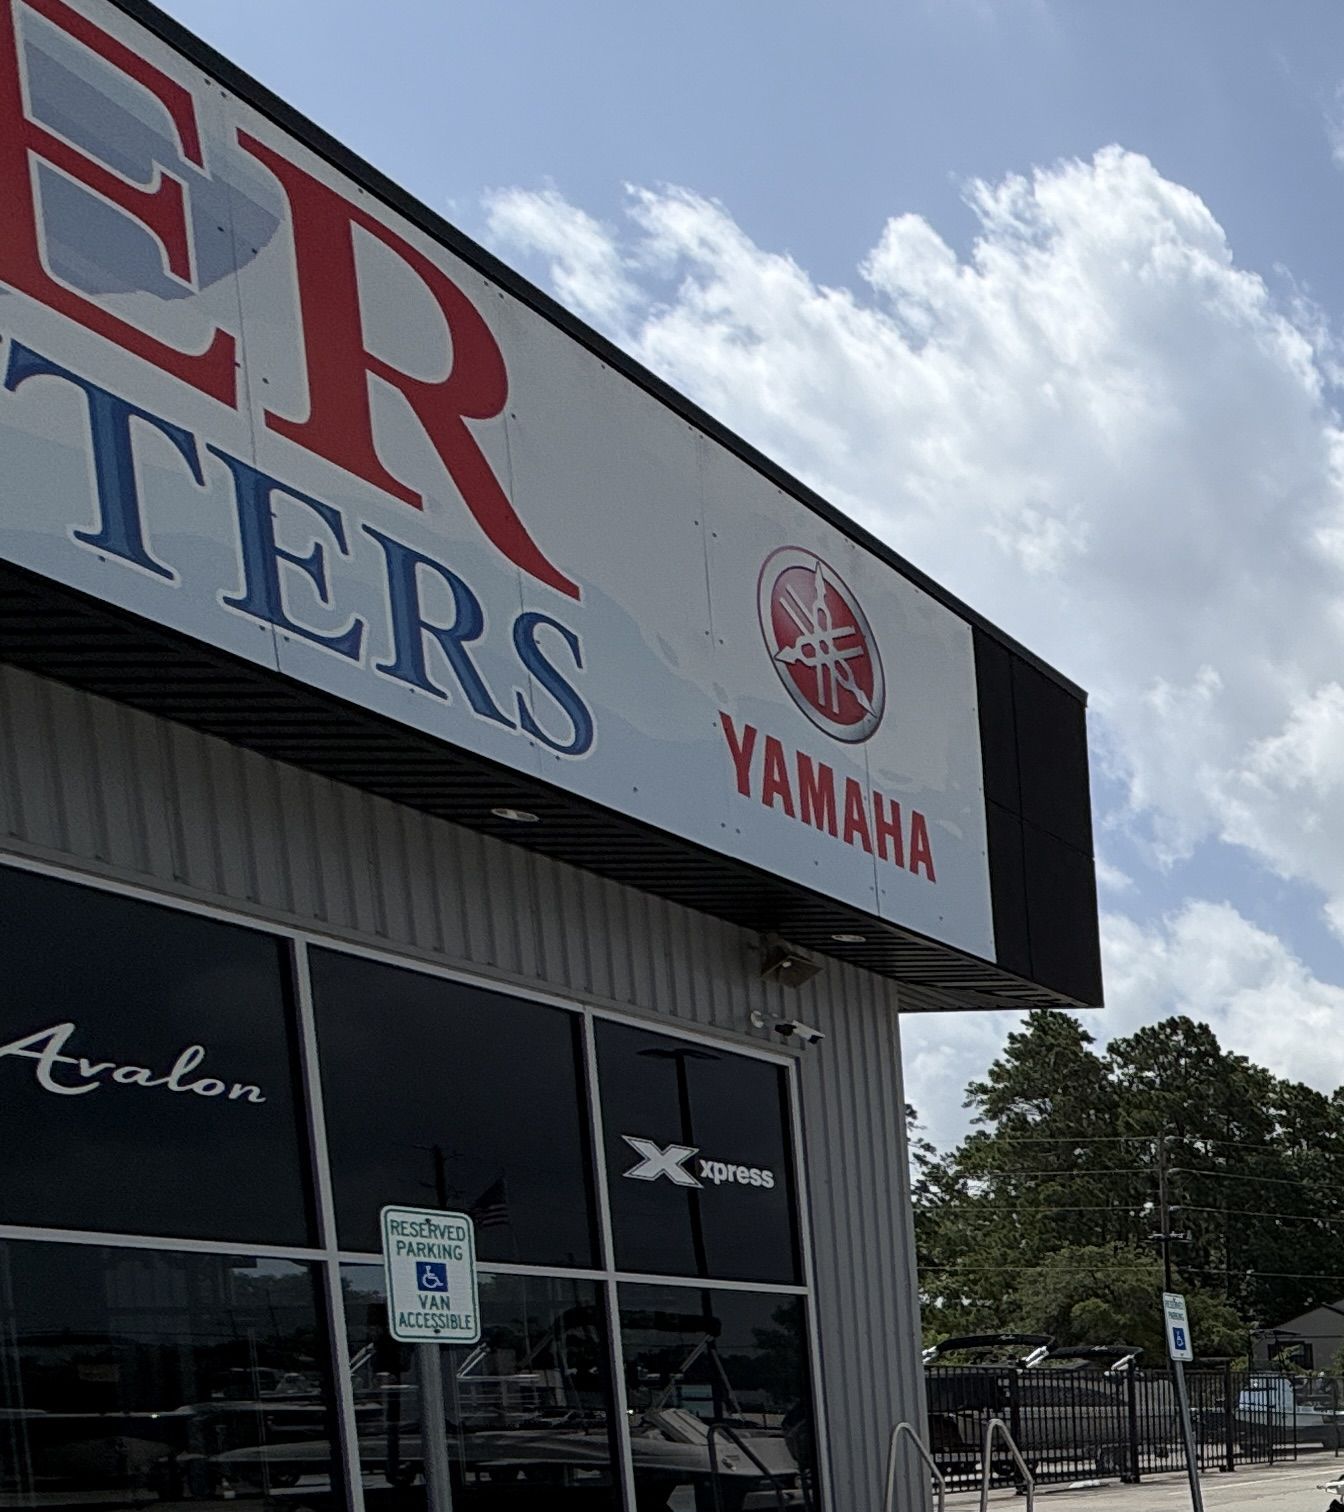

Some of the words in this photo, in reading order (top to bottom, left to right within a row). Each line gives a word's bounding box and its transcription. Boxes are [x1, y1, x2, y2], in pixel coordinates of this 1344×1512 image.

[4, 339, 594, 757] TERS
[719, 711, 936, 883] YAMAHA
[0, 1023, 266, 1103] Avalon
[390, 1219, 466, 1242] RESERVED
[396, 1240, 463, 1261] PARKING
[417, 1294, 450, 1311] VAN
[399, 1311, 473, 1330] ACCESSIBLE
